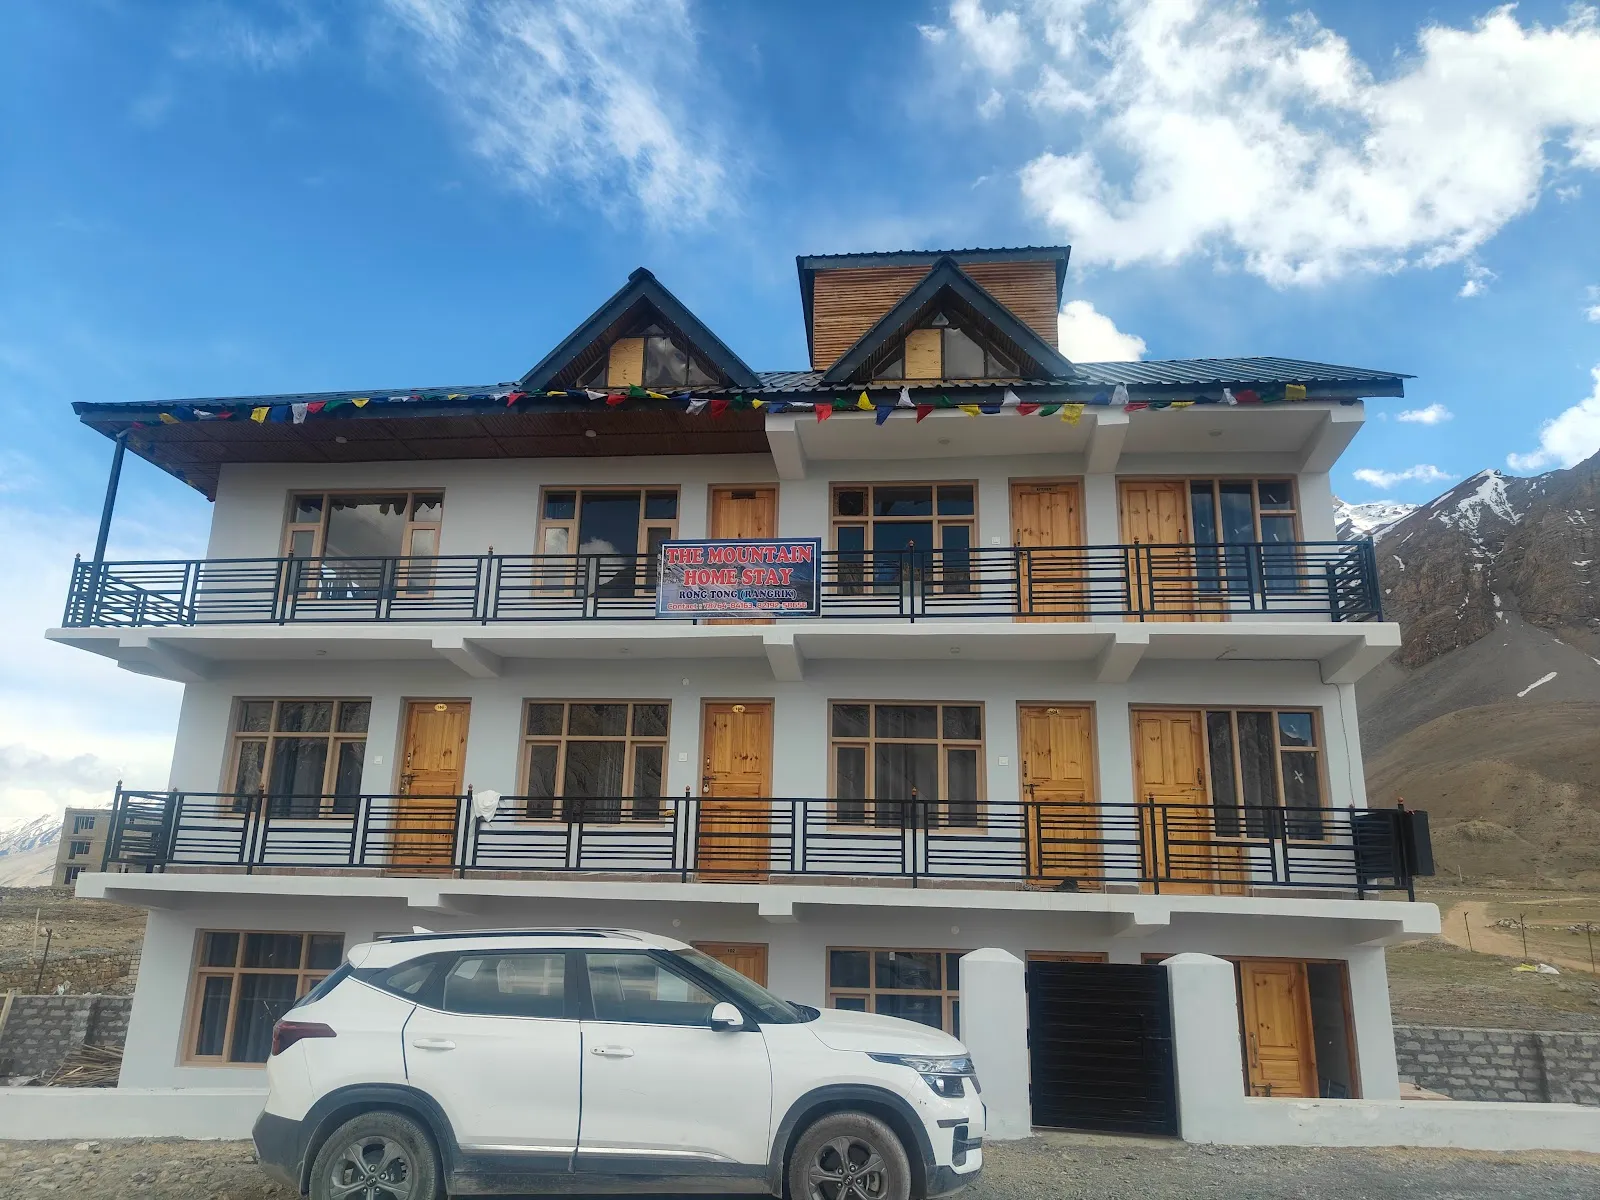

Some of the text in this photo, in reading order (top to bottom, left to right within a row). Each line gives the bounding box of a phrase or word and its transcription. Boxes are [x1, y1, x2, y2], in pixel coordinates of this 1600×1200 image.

[666, 545, 812, 564] THE MOUNTAIN
[683, 567, 793, 586] HOME STAY
[679, 589, 797, 600] RONG TONG (RANGRIK)
